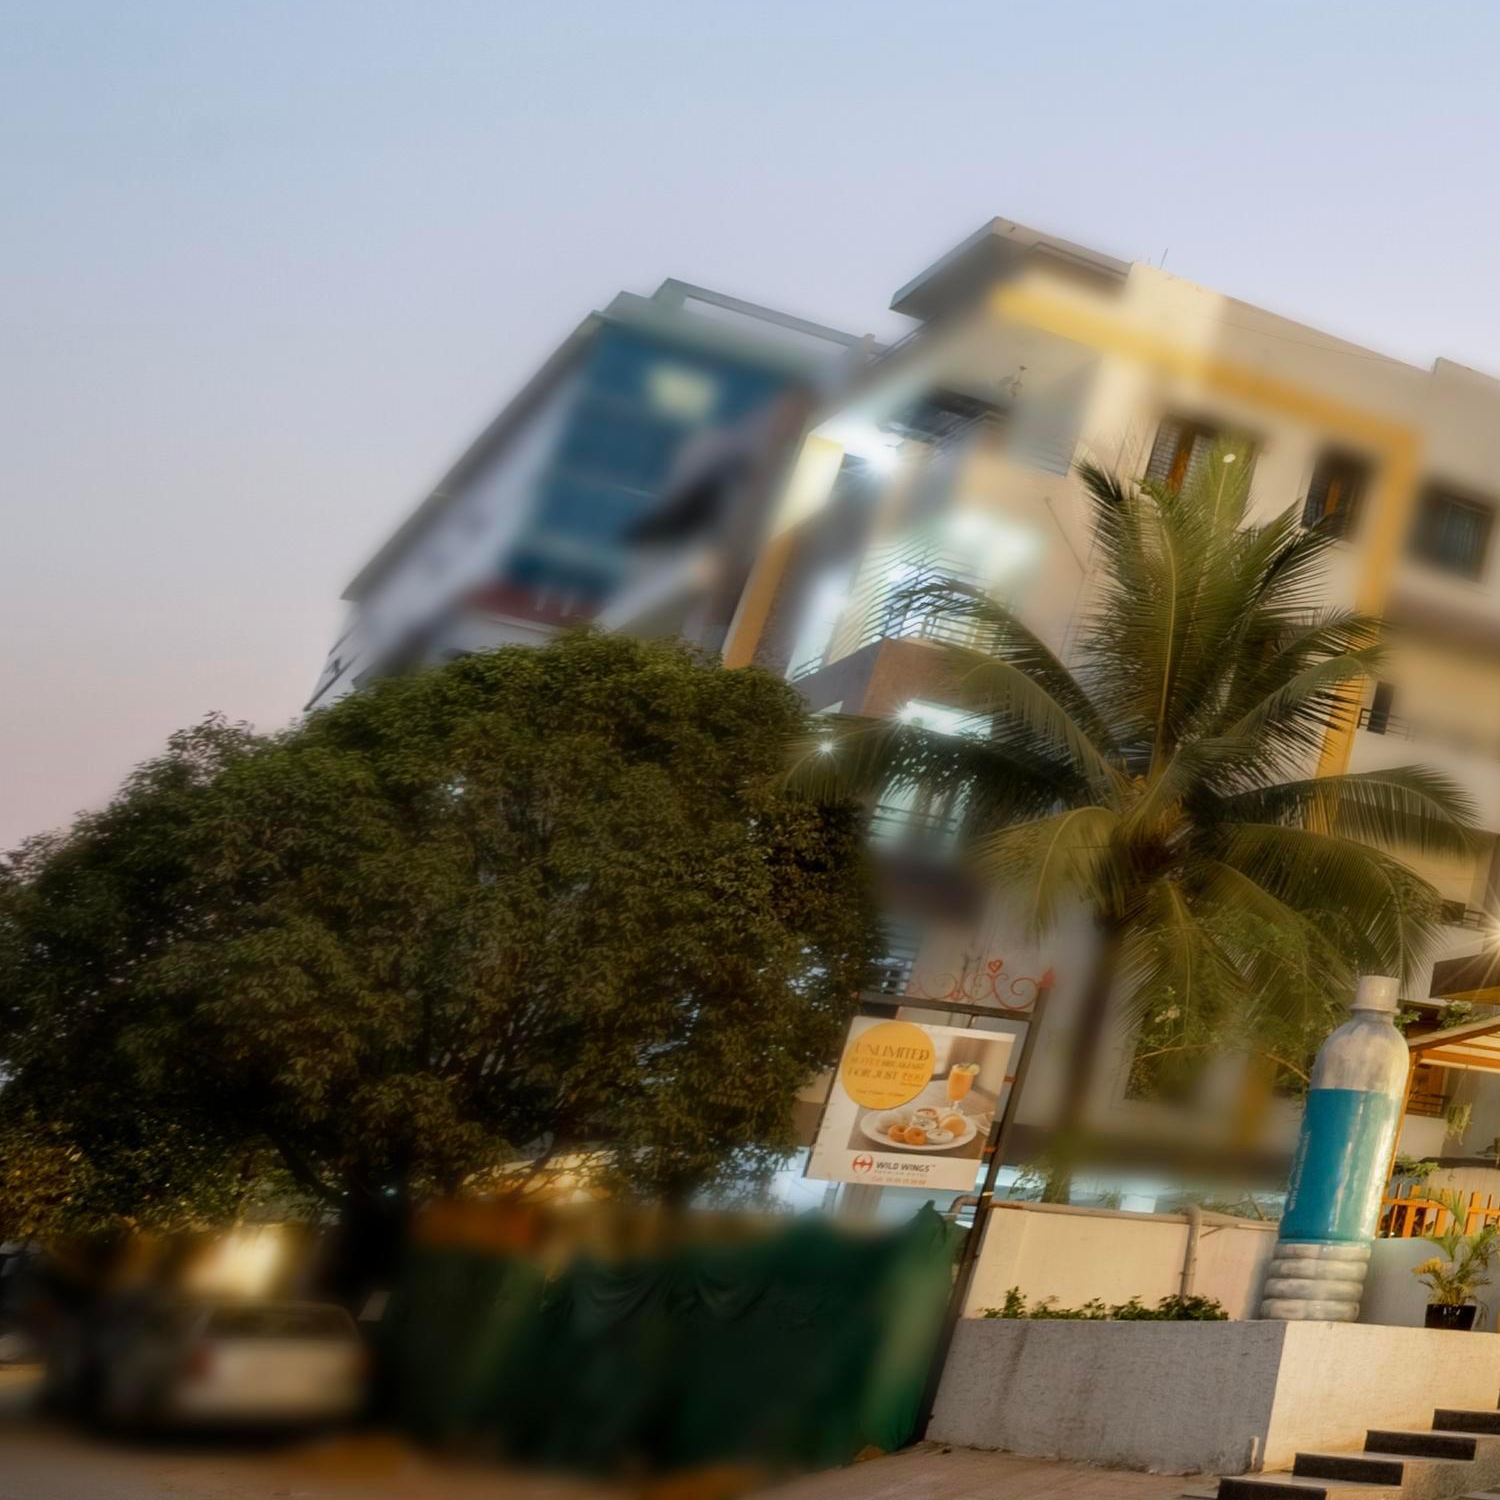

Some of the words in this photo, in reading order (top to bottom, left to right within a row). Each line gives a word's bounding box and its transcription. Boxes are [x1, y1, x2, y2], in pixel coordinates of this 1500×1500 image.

[855, 1043, 930, 1061] UNLIMITED
[876, 1161, 899, 1171] WILD
[901, 1162, 930, 1173] WINGS
